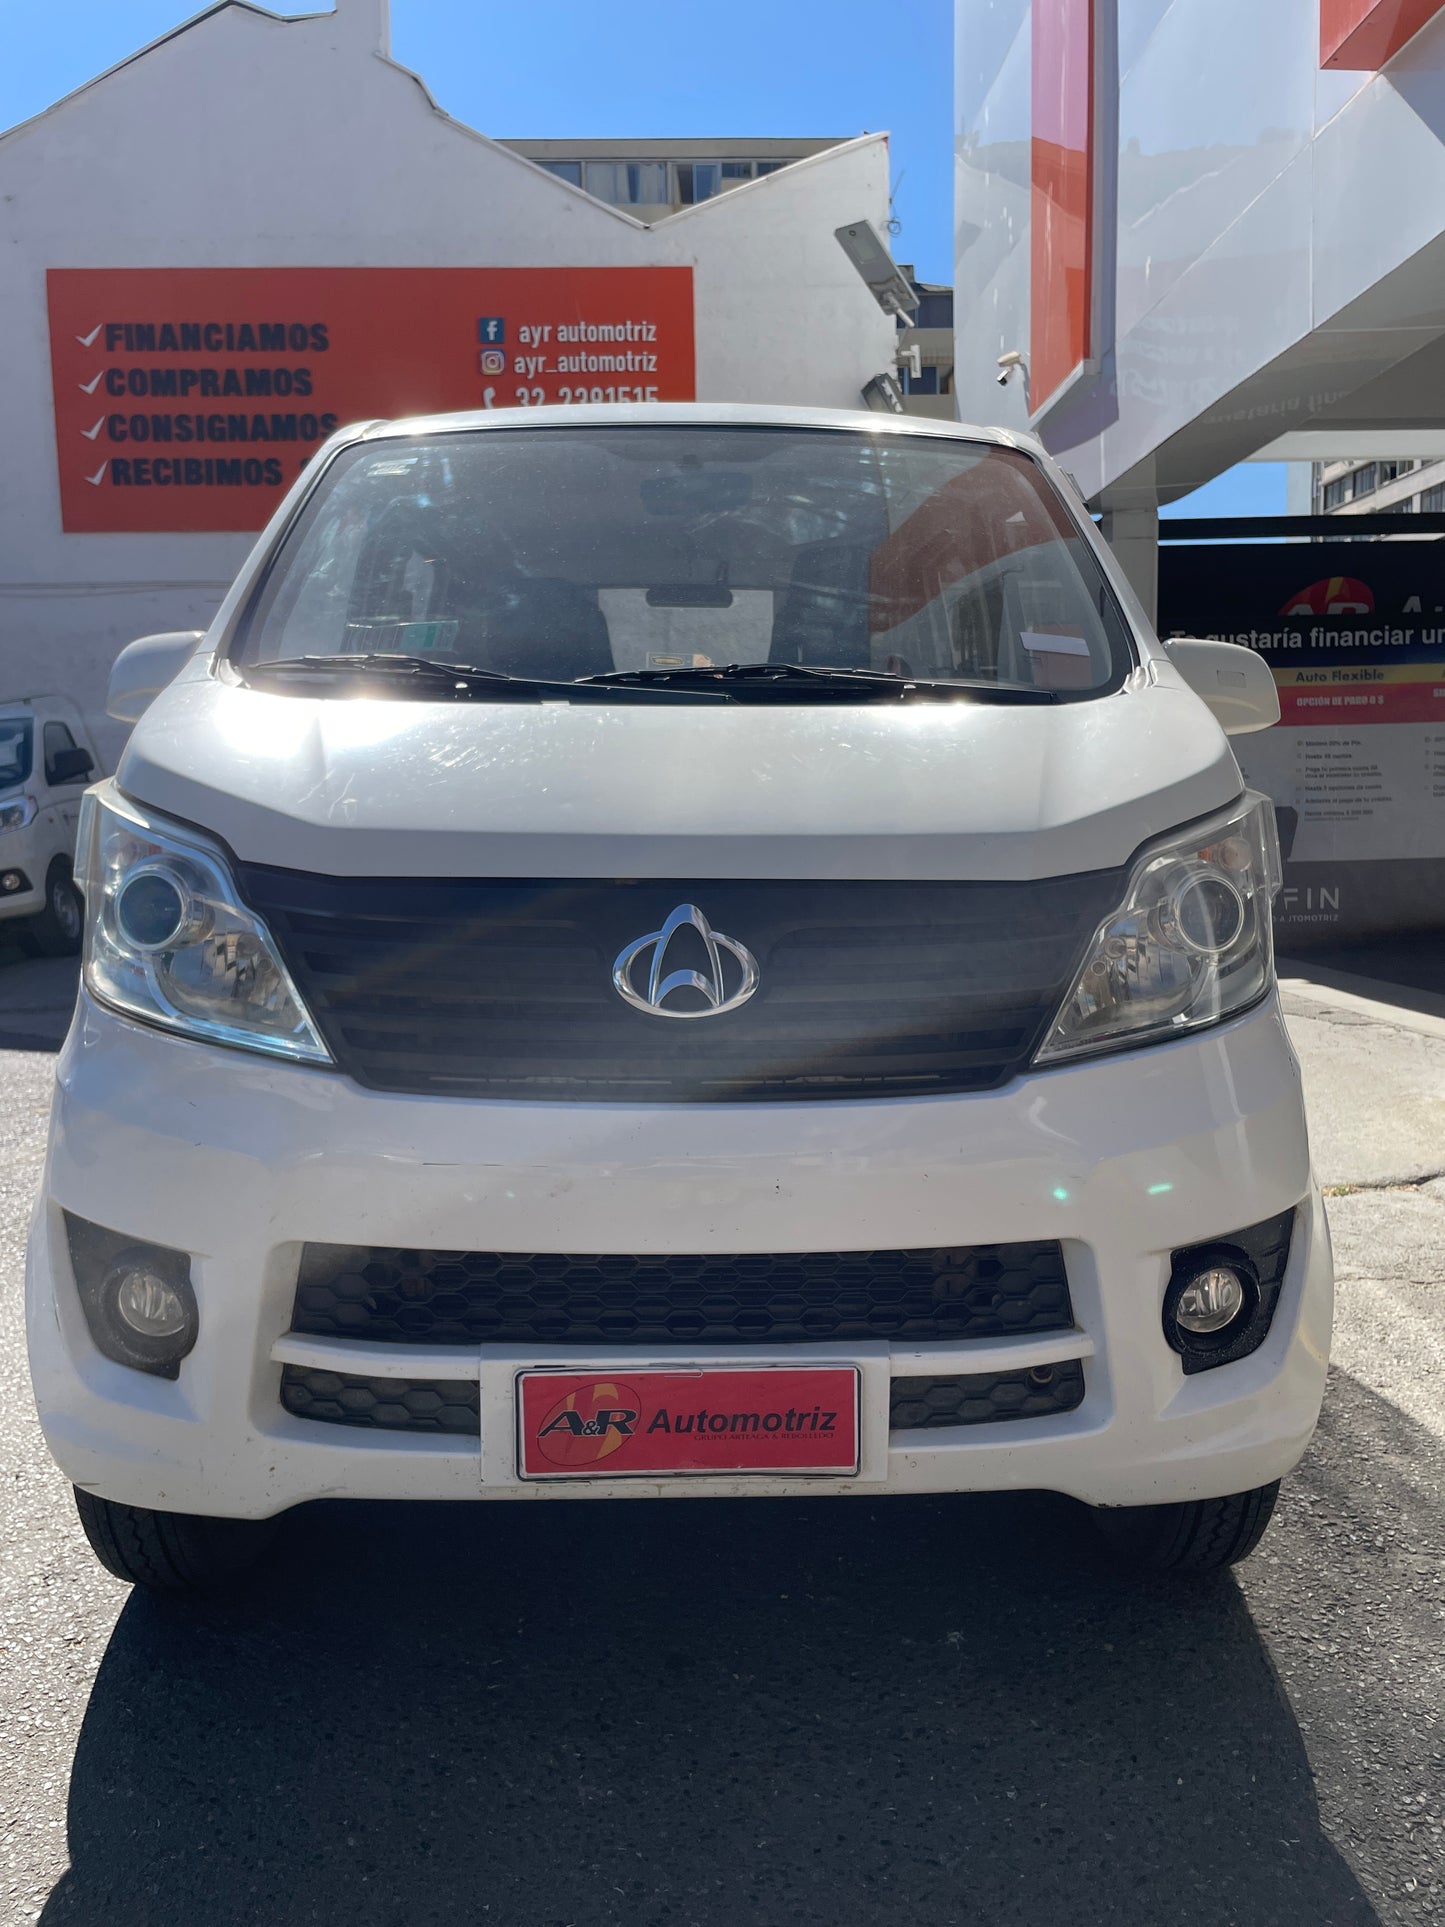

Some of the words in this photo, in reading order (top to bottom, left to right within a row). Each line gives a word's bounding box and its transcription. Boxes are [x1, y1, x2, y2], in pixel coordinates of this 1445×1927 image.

[105, 322, 330, 352] FINANCIAMOS
[518, 325, 552, 348] ayr
[557, 320, 657, 342] automotriz
[514, 351, 658, 380] ayr_automotriz
[105, 368, 313, 397] COMPRAMOS
[107, 412, 339, 443] CONSIGNAMOS
[111, 458, 283, 486] RECIBIMOS
[1309, 625, 1414, 648] financiar
[1296, 671, 1327, 682] Auto
[1332, 669, 1385, 682] Flexible
[536, 1409, 637, 1438] A&R
[646, 1406, 838, 1434] Automotriz
